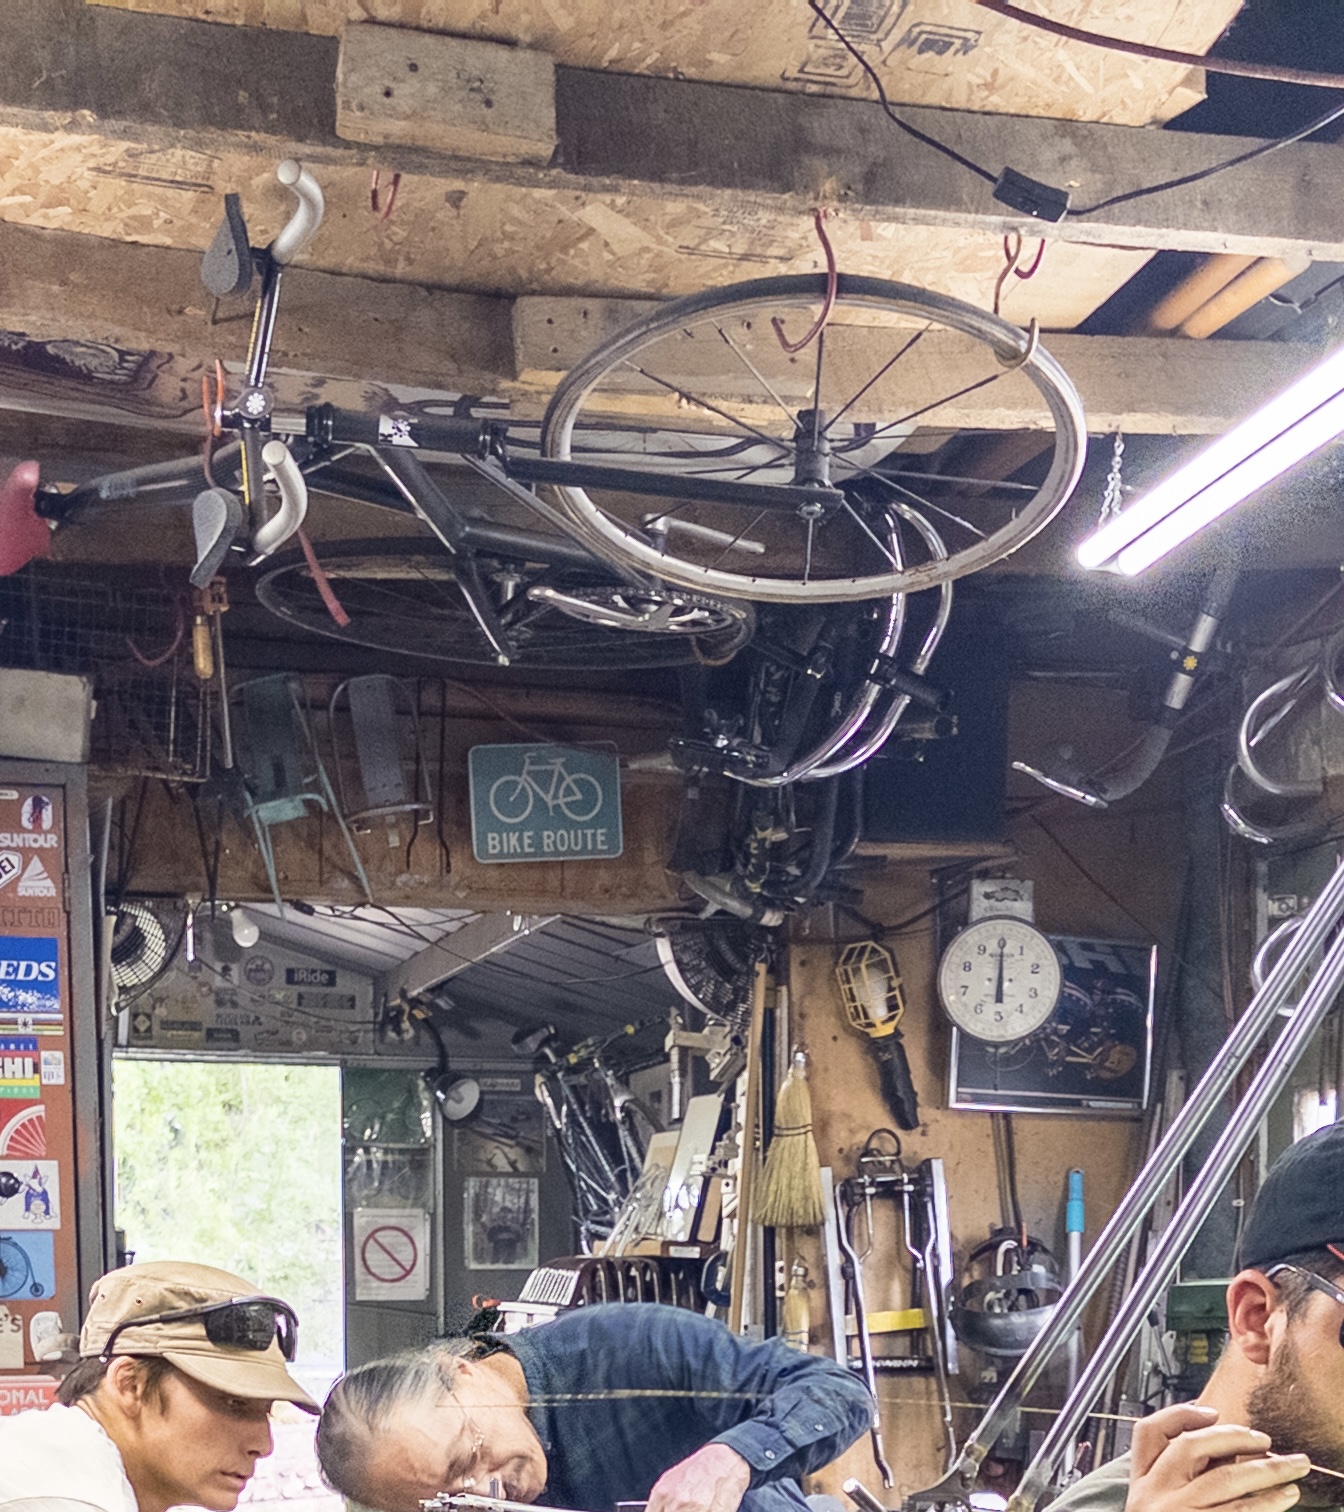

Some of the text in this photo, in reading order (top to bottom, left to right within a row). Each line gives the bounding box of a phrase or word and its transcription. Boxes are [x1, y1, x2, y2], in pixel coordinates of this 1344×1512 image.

[487, 828, 608, 855] BIKE ROUTE
[977, 944, 987, 955] 9
[1017, 945, 1025, 955] 1
[962, 961, 973, 973] 8
[1031, 963, 1041, 975] 2
[294, 969, 329, 983] iRide
[960, 985, 970, 997] 7
[1029, 987, 1039, 999] 3
[974, 1003, 984, 1015] 6
[1015, 1003, 1024, 1014] 4
[994, 1011, 1004, 1023] 5
